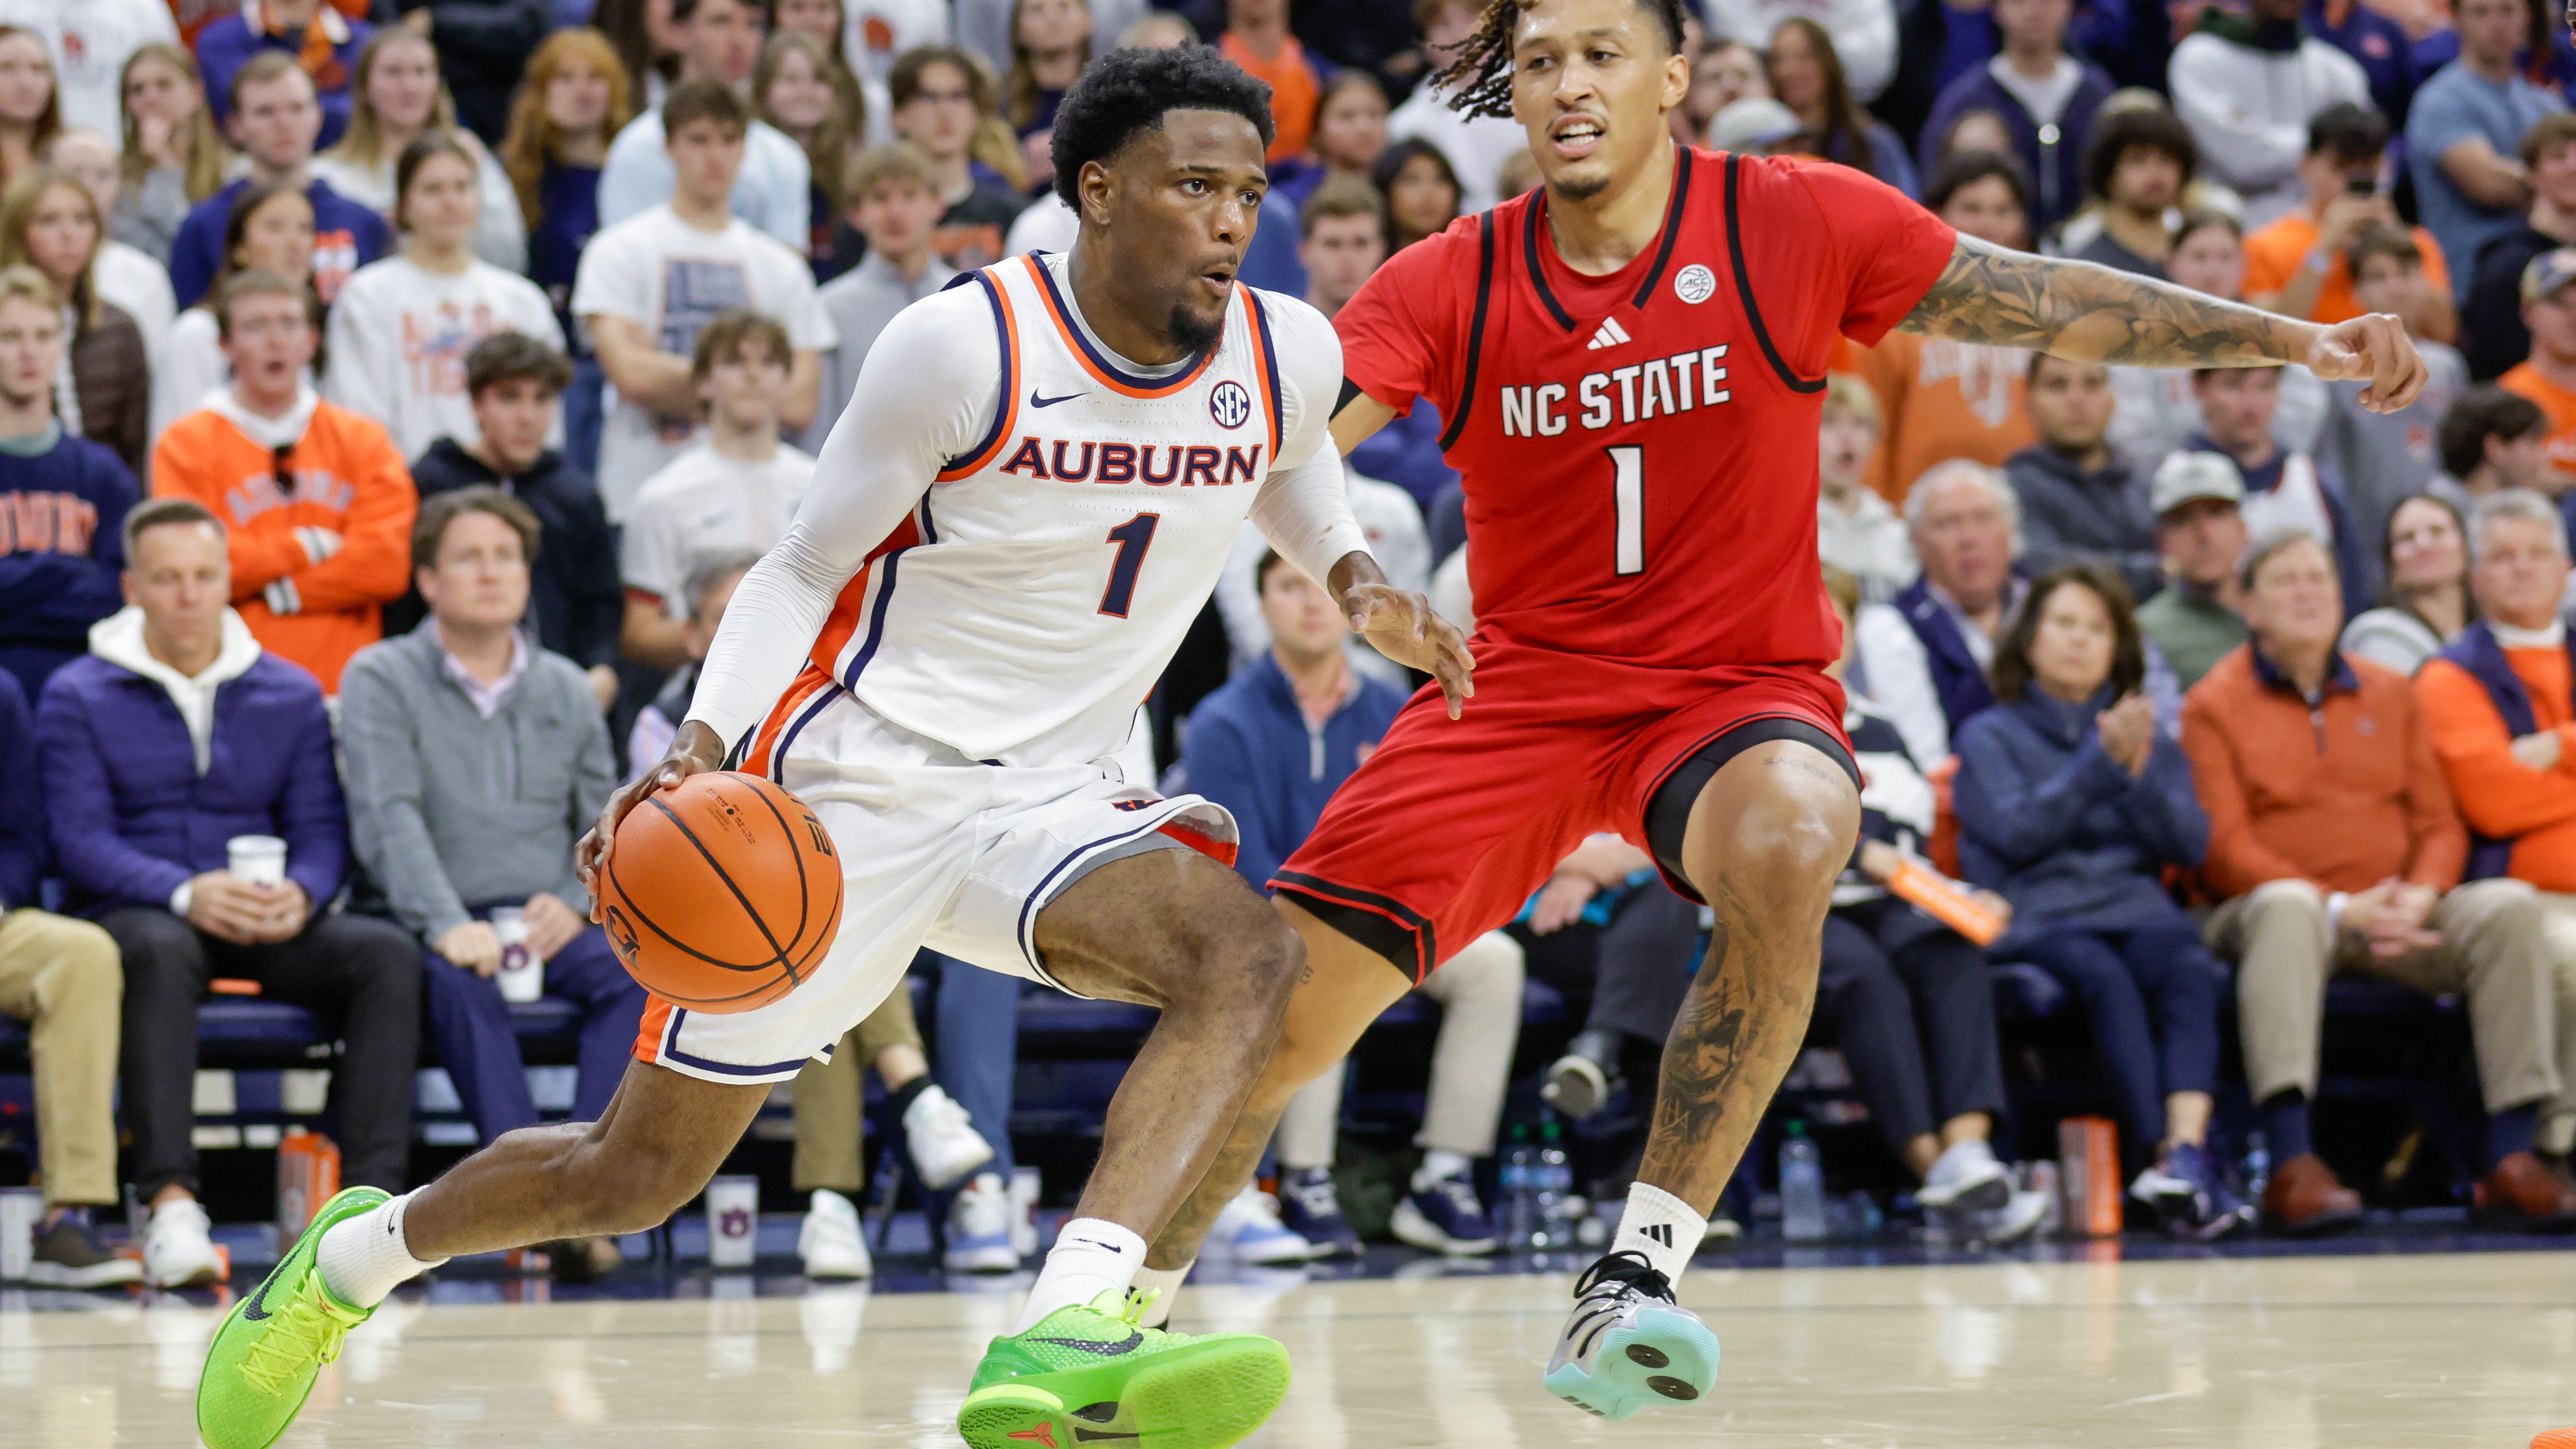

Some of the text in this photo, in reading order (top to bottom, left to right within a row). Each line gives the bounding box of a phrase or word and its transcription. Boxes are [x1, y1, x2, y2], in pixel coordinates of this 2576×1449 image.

[1683, 277, 1708, 286] ACC
[1212, 384, 1248, 426] SEC
[1500, 343, 1731, 438] NC STATE
[1000, 436, 1263, 487] AUBURN
[1602, 443, 1646, 577] 1
[1097, 512, 1161, 620] 1
